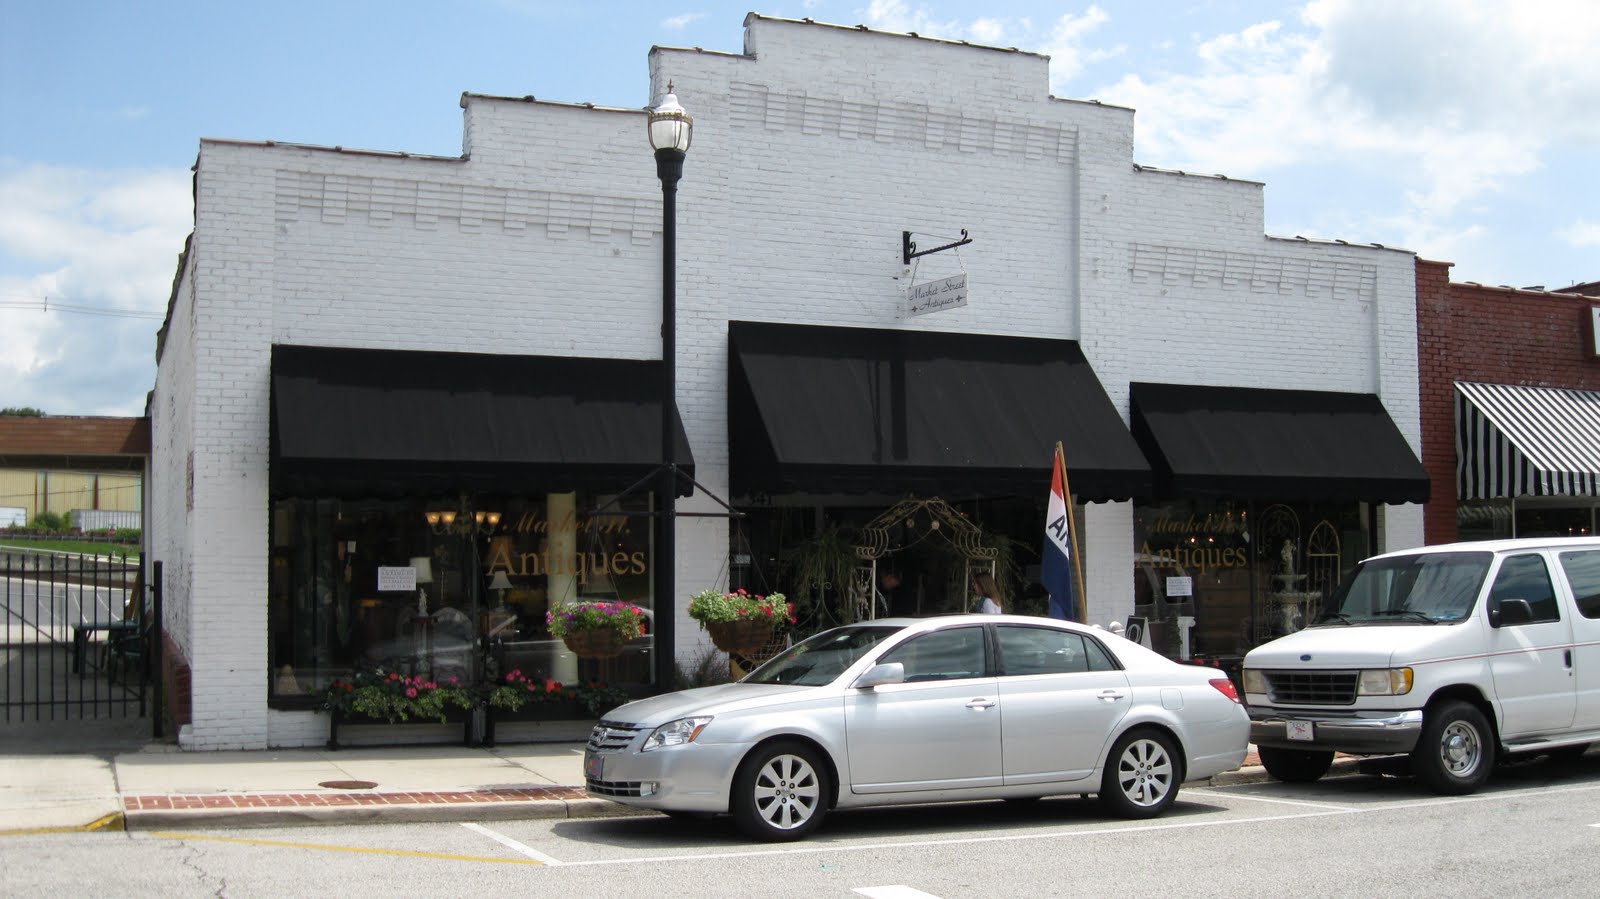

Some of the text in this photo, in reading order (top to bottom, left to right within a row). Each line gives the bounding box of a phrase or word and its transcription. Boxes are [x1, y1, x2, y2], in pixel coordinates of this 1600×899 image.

[909, 279, 965, 300] Market Street
[920, 297, 954, 310] Antiques
[502, 510, 593, 534] Market
[485, 542, 647, 585] Antiques
[1134, 540, 1248, 576] Antiques
